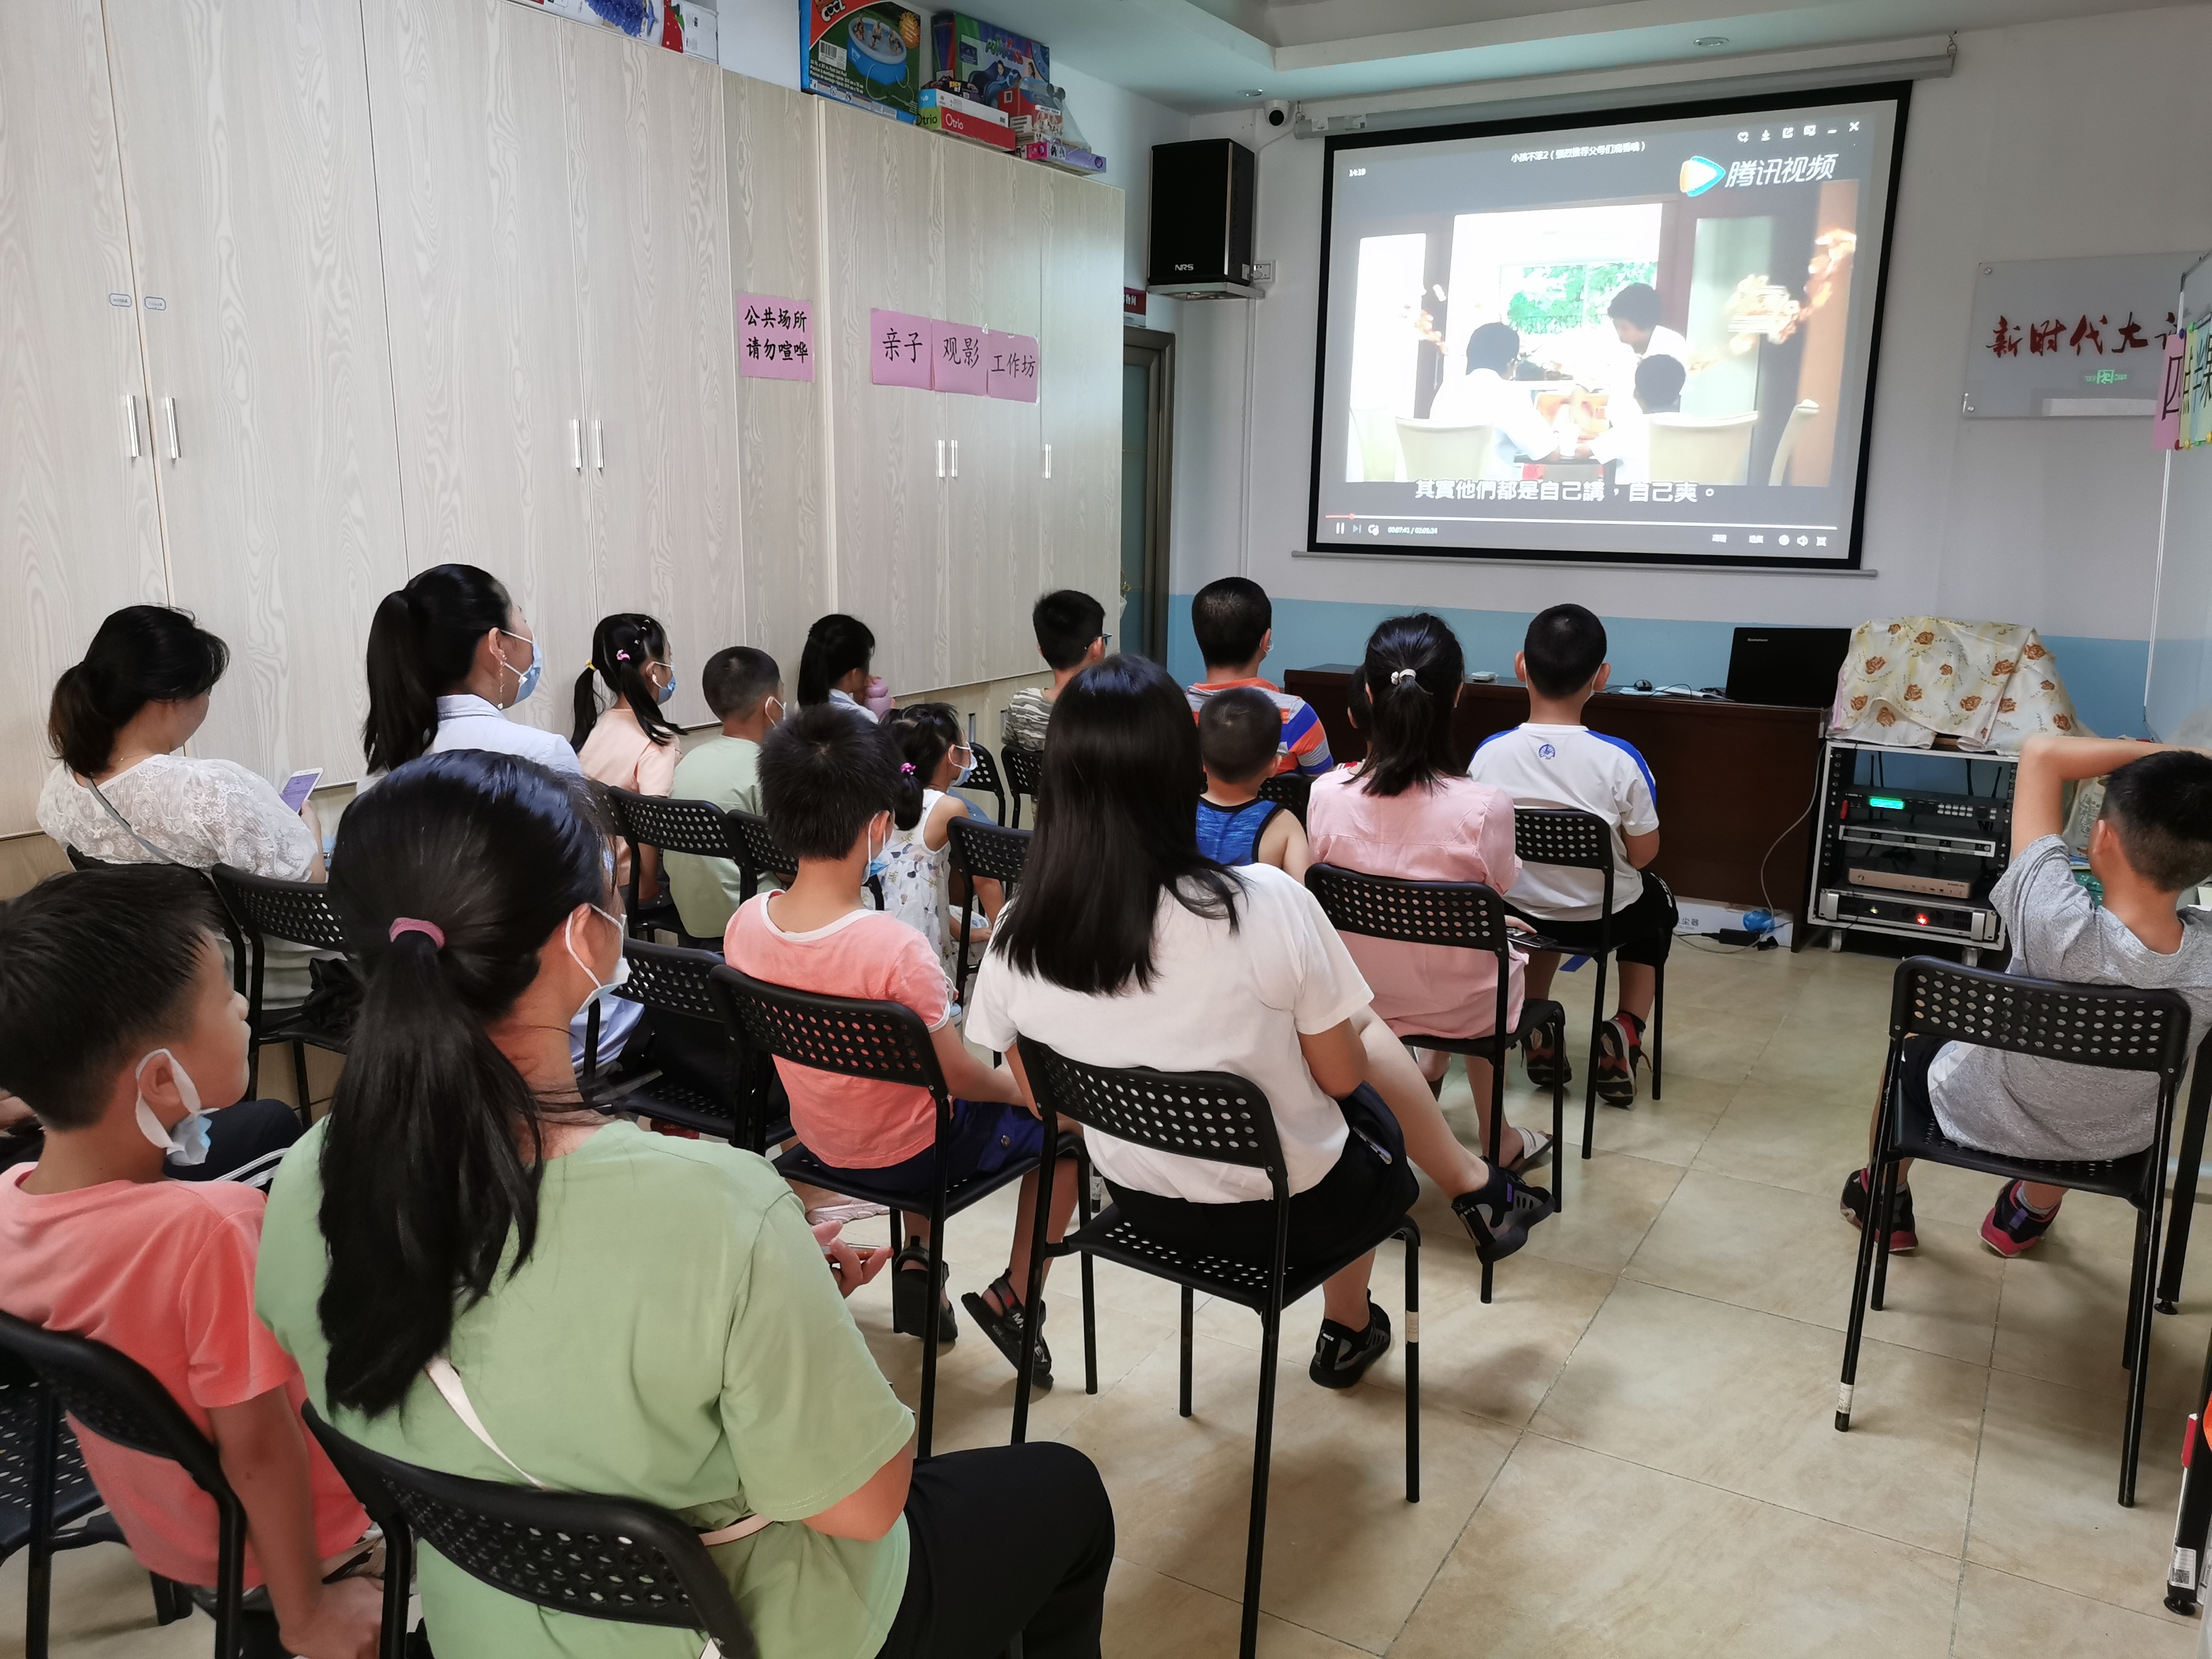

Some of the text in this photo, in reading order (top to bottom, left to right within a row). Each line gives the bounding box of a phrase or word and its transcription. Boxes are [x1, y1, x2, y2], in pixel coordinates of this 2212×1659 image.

[945, 113, 964, 130] Otrio
[1724, 153, 1839, 188] 腾讯视频
[744, 305, 808, 333] 公共场所
[746, 337, 808, 364] 请勿喧哗
[882, 327, 1037, 379] 亲子 观影 工作坊
[1678, 917, 1699, 927] 尘器
